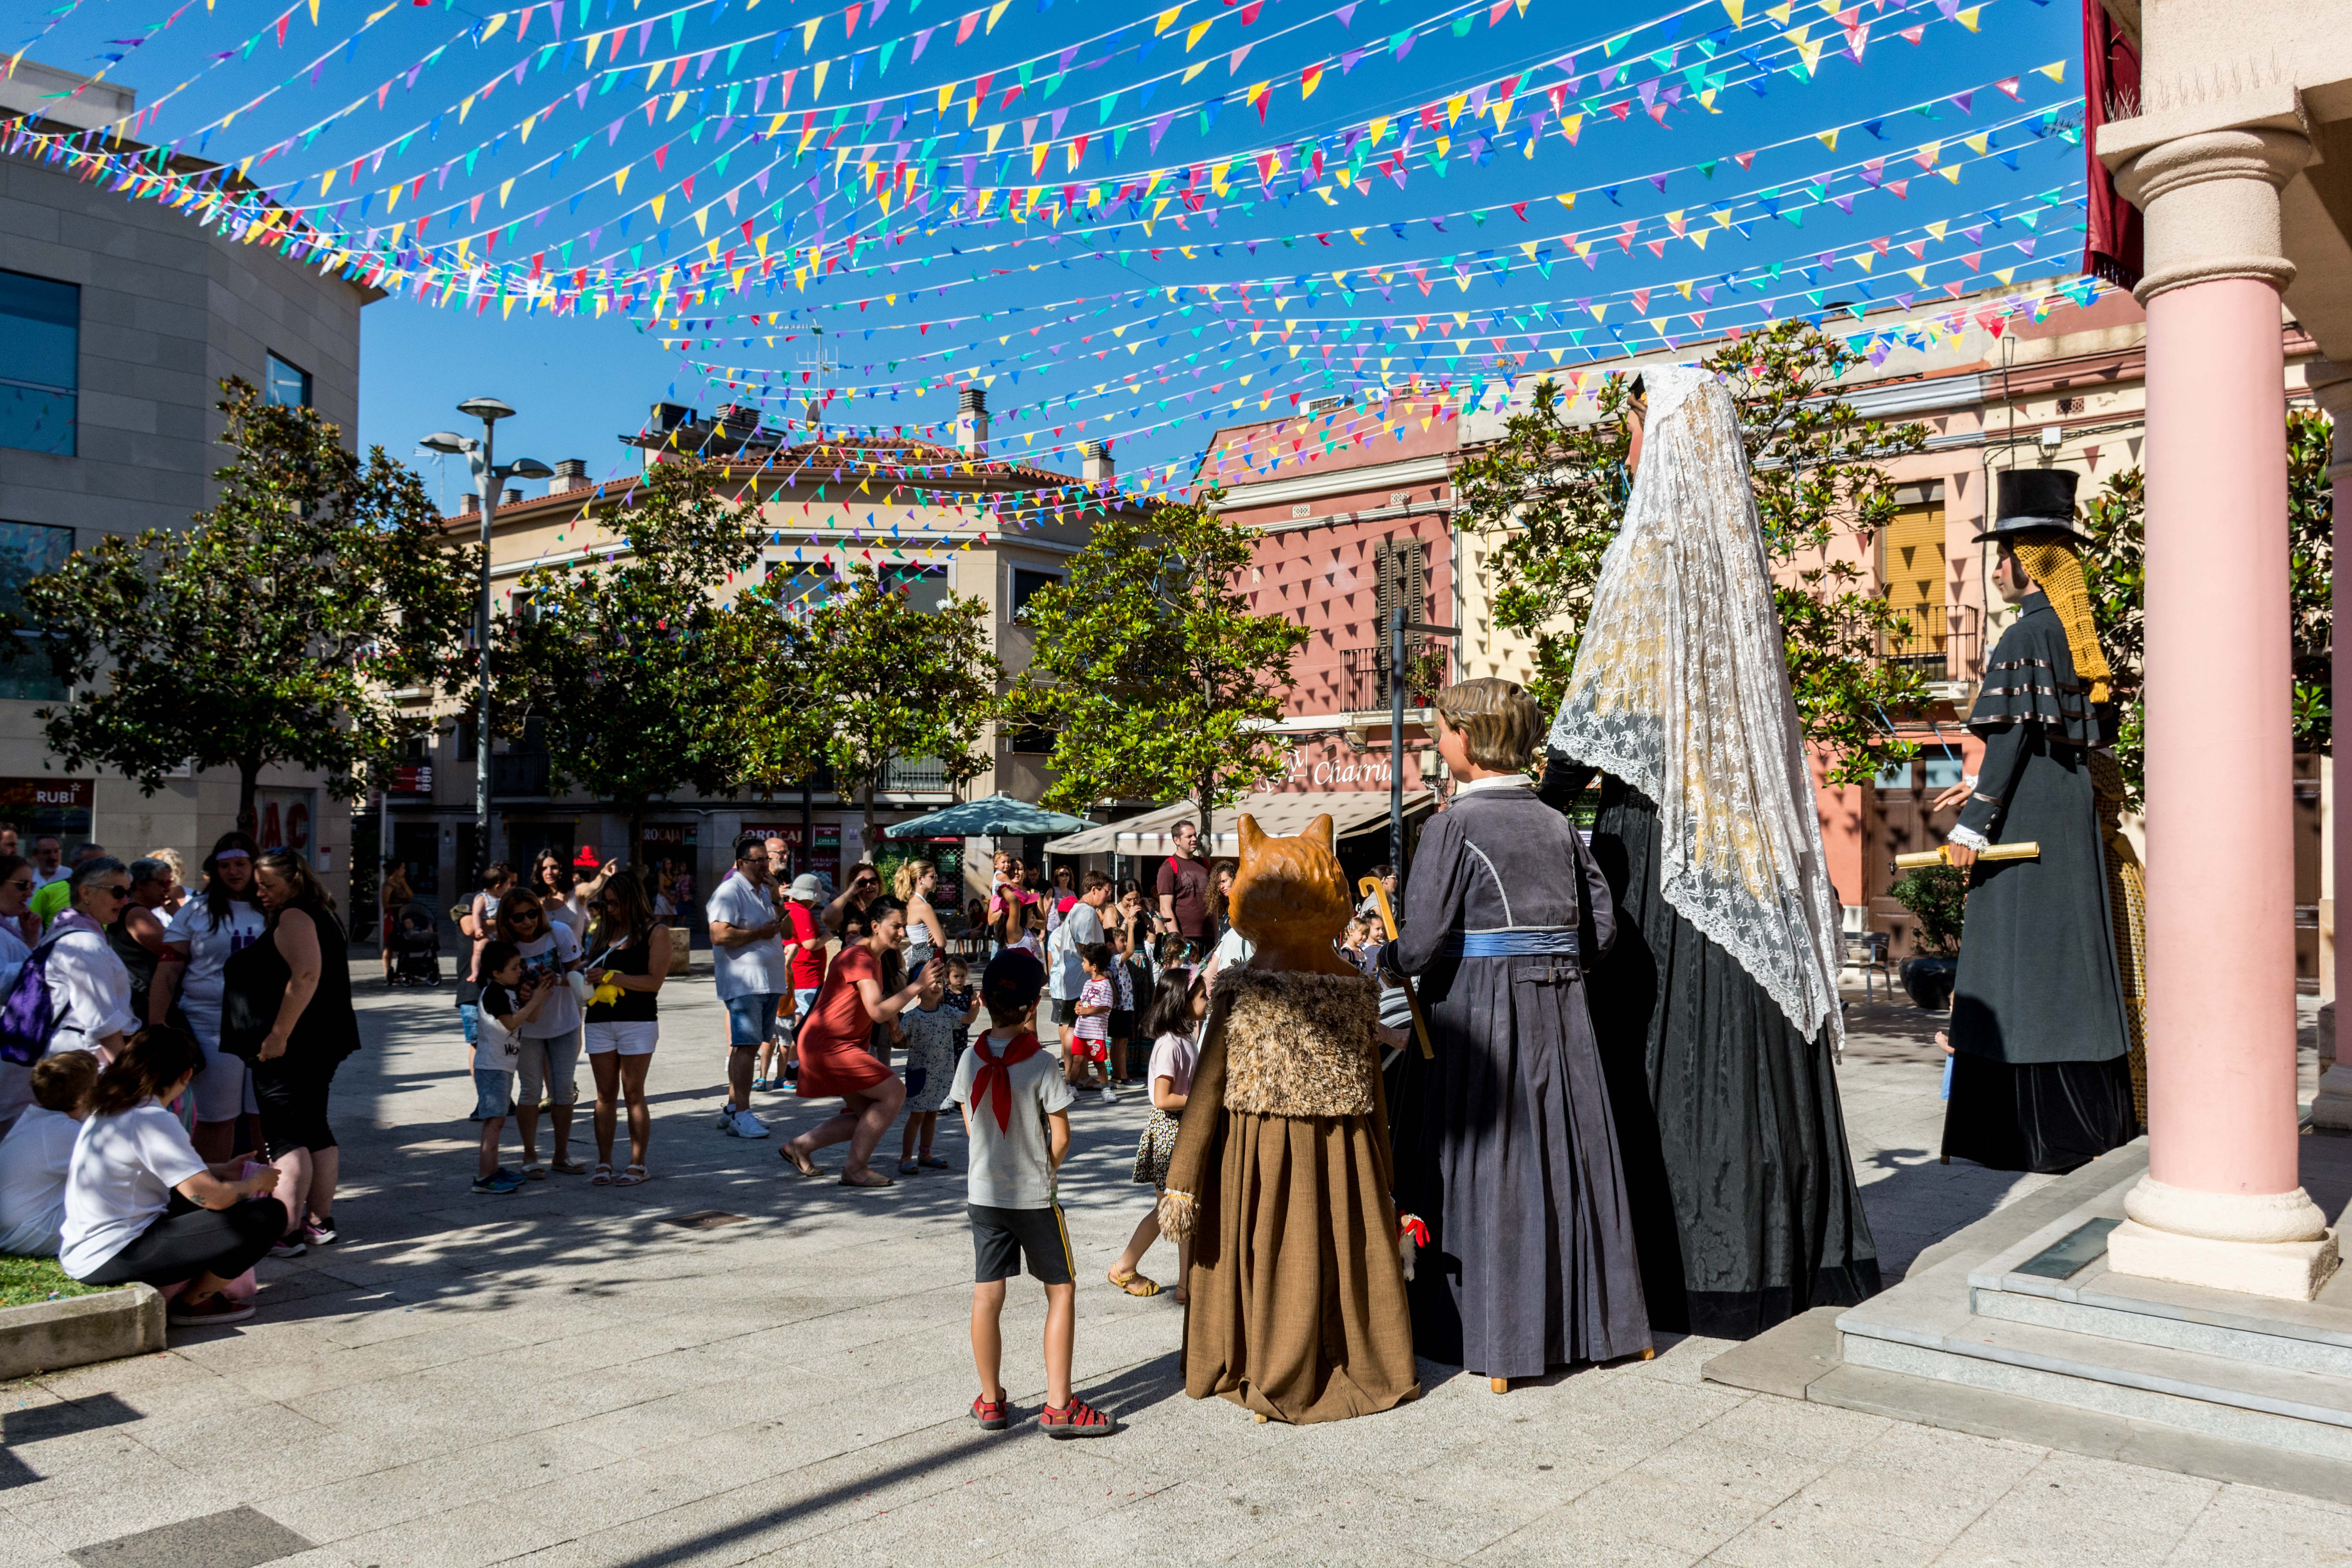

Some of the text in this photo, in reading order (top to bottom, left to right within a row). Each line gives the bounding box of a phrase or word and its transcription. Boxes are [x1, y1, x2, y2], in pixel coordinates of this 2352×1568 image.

[1314, 758, 1392, 785] Charrú
[252, 802, 308, 849] AC
[643, 828, 681, 842] ROCAJA
[745, 829, 803, 843] OROCAJ
